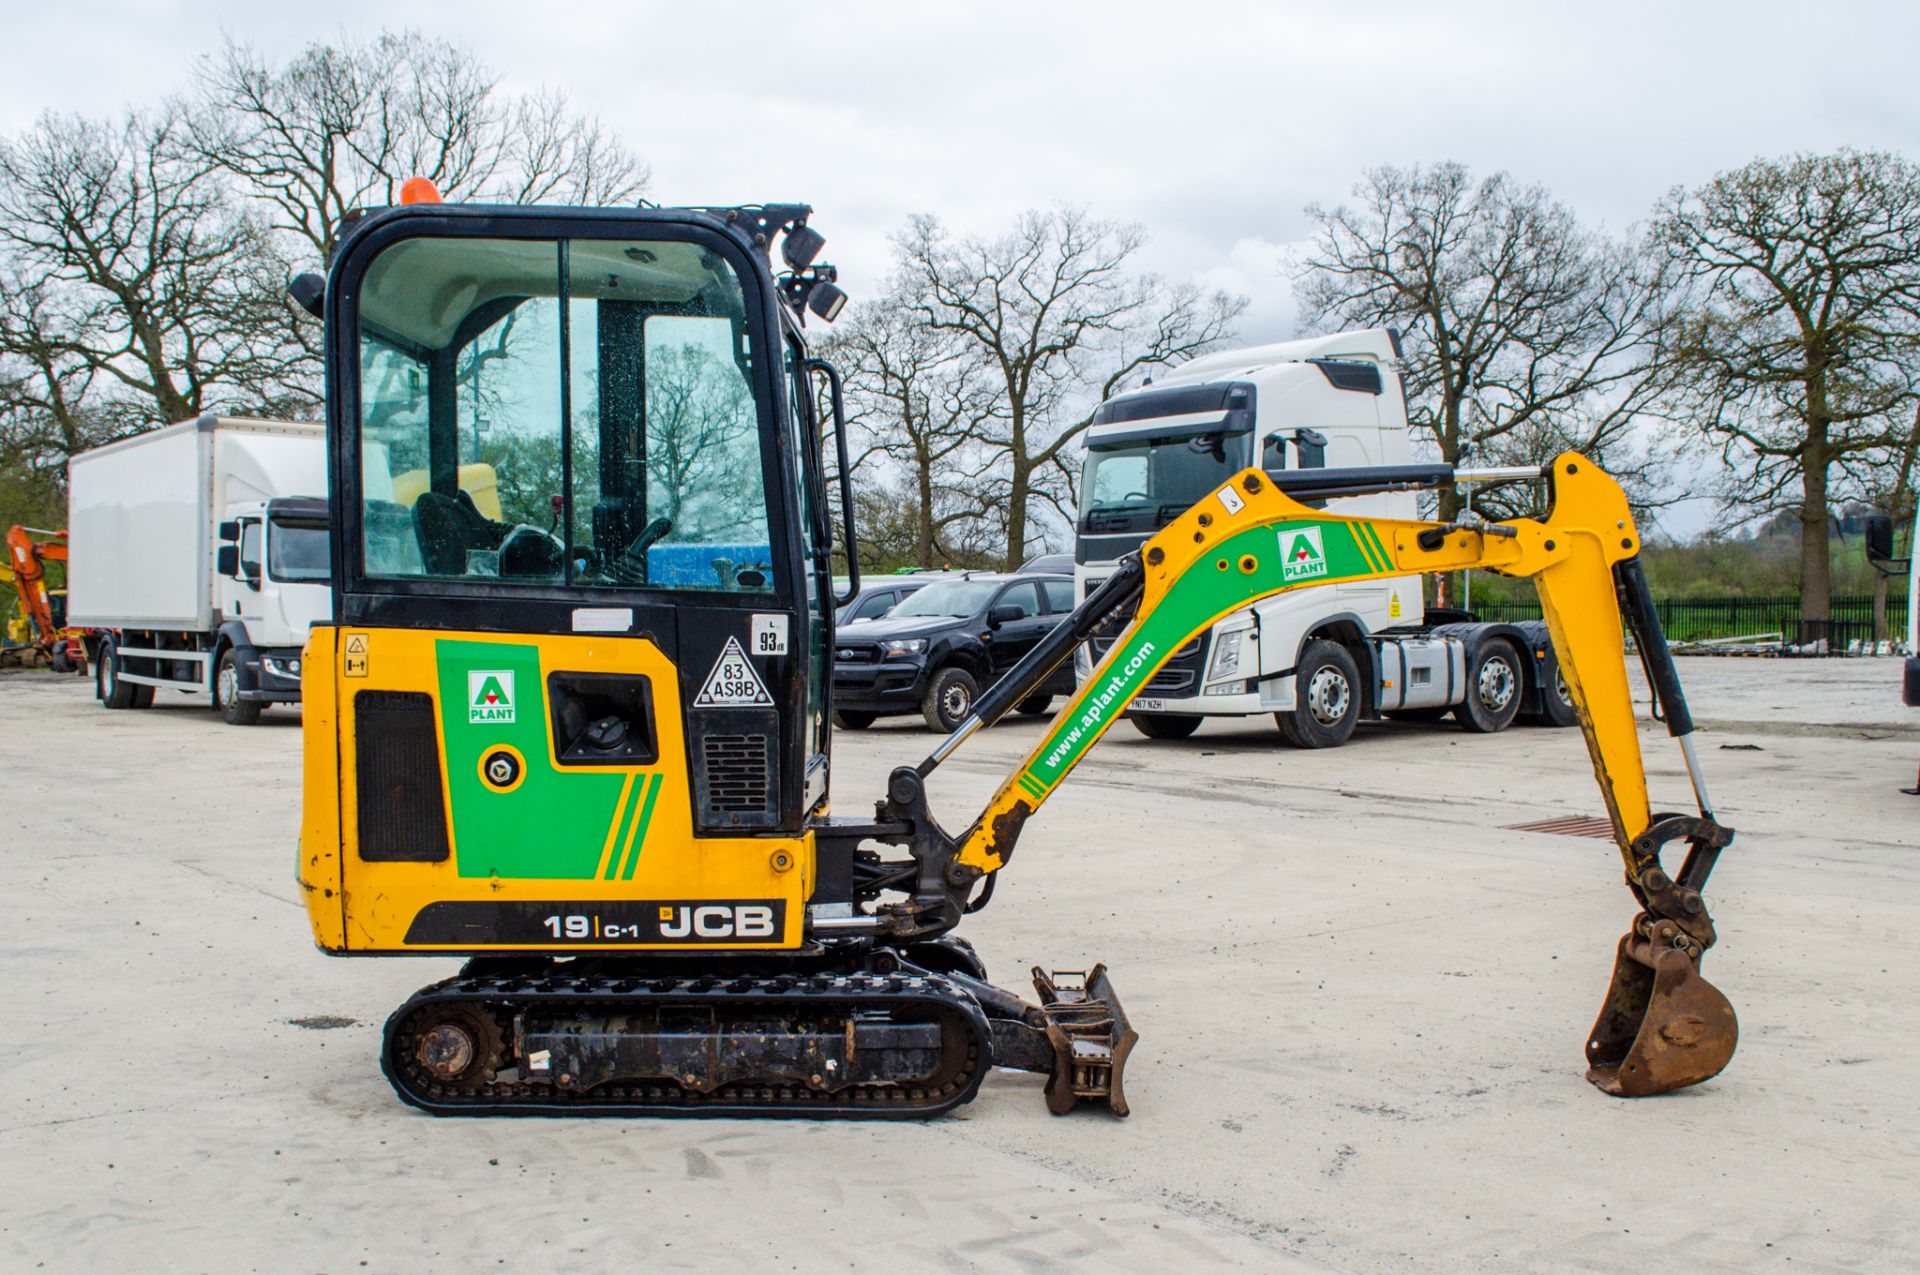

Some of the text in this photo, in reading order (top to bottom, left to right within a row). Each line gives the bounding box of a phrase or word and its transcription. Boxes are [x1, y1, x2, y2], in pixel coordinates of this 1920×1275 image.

[1287, 533, 1320, 563] A
[1284, 561, 1325, 577] PLANT
[723, 664, 743, 680] 83
[474, 676, 511, 705] A
[714, 681, 755, 698] AS8B
[471, 709, 514, 720] PLANT
[1045, 641, 1155, 768] www.aplant.com
[543, 915, 589, 938] 19
[659, 906, 774, 937] JCB
